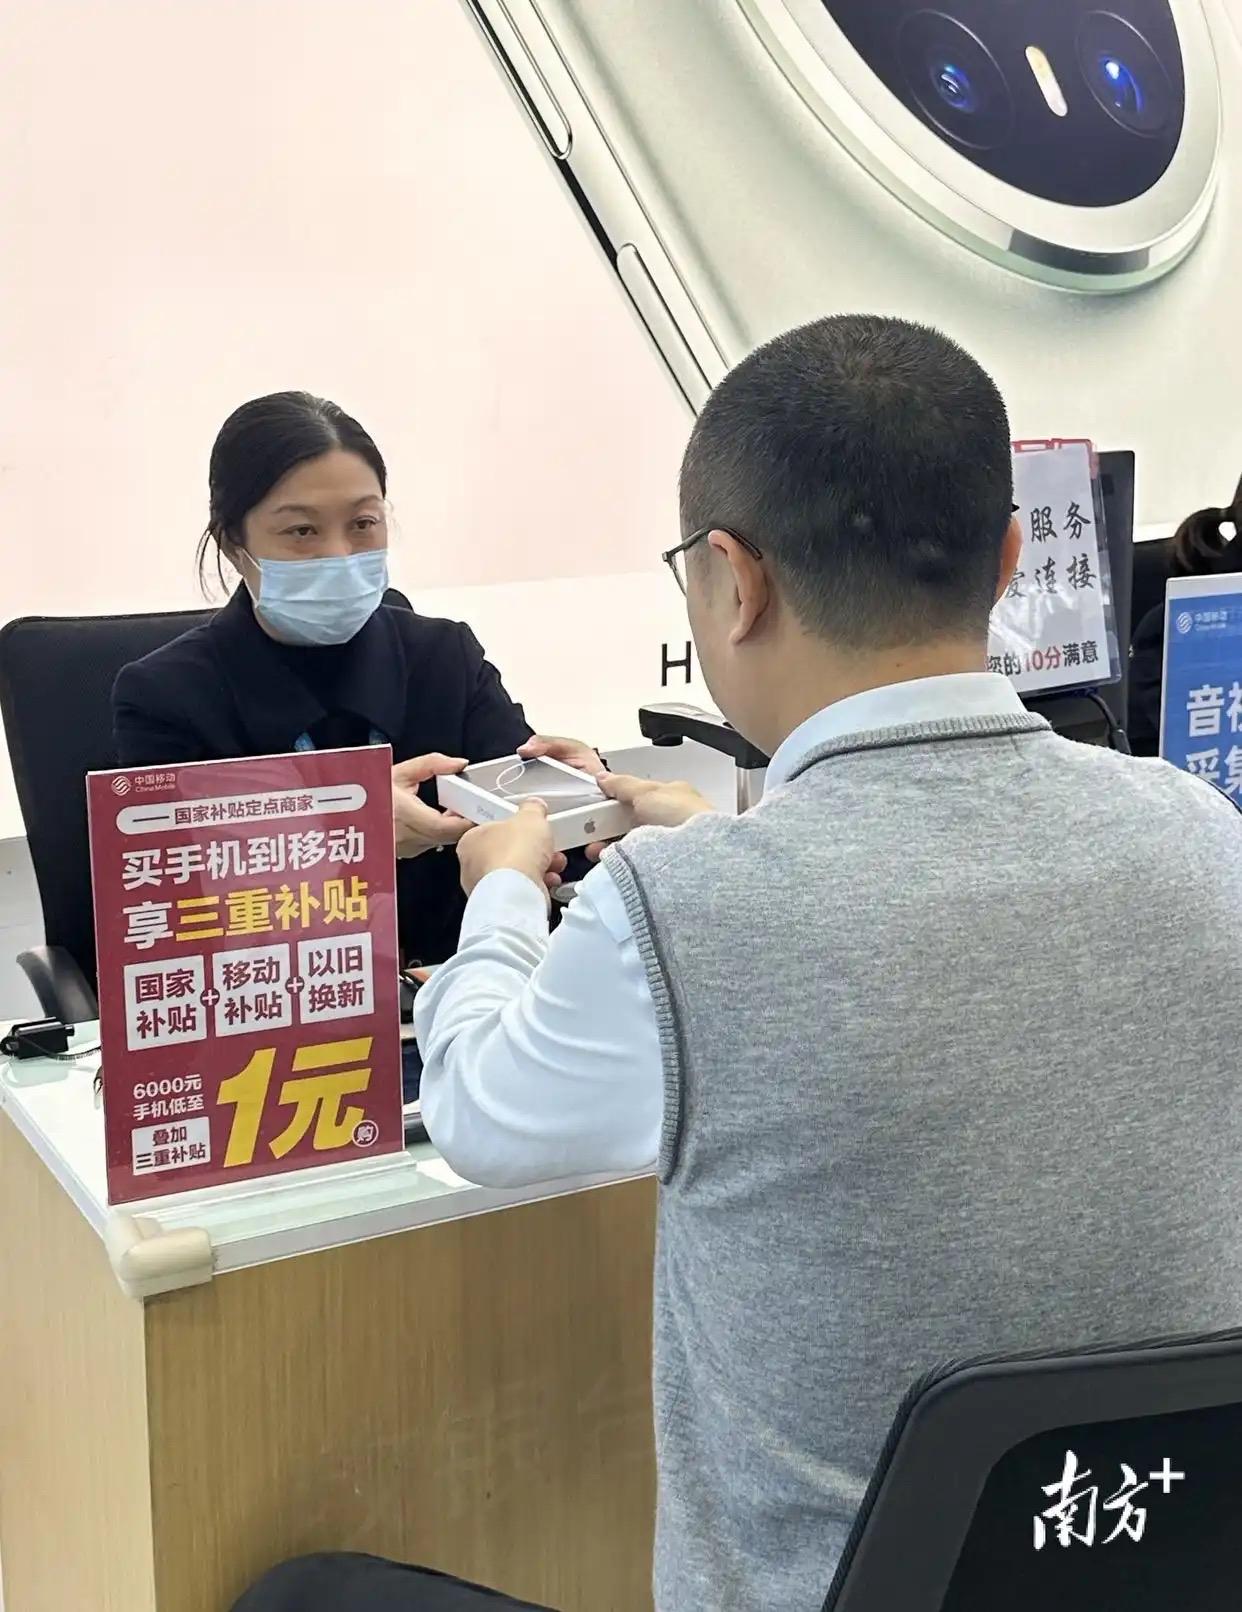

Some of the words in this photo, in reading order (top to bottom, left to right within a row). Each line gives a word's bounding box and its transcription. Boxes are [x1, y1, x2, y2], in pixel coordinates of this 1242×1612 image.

[1030, 502, 1092, 543] 服务
[134, 772, 176, 785] 中国移动
[174, 794, 314, 825] 国家补贴定点商家
[121, 825, 365, 890] 买手机到移动
[123, 875, 369, 950] 享三重补贴
[222, 956, 281, 990] 移动
[307, 945, 363, 978] 以旧
[135, 969, 196, 1004] 国家
[309, 978, 365, 1013] 换新
[136, 1003, 197, 1039] 补贴
[224, 991, 282, 1026] 补贴
[133, 1073, 202, 1100] 6000元
[216, 1036, 374, 1168] 1元
[133, 1094, 205, 1121] 手机低至
[153, 1125, 187, 1145] 叠加
[136, 1142, 206, 1170] 三重补贴
